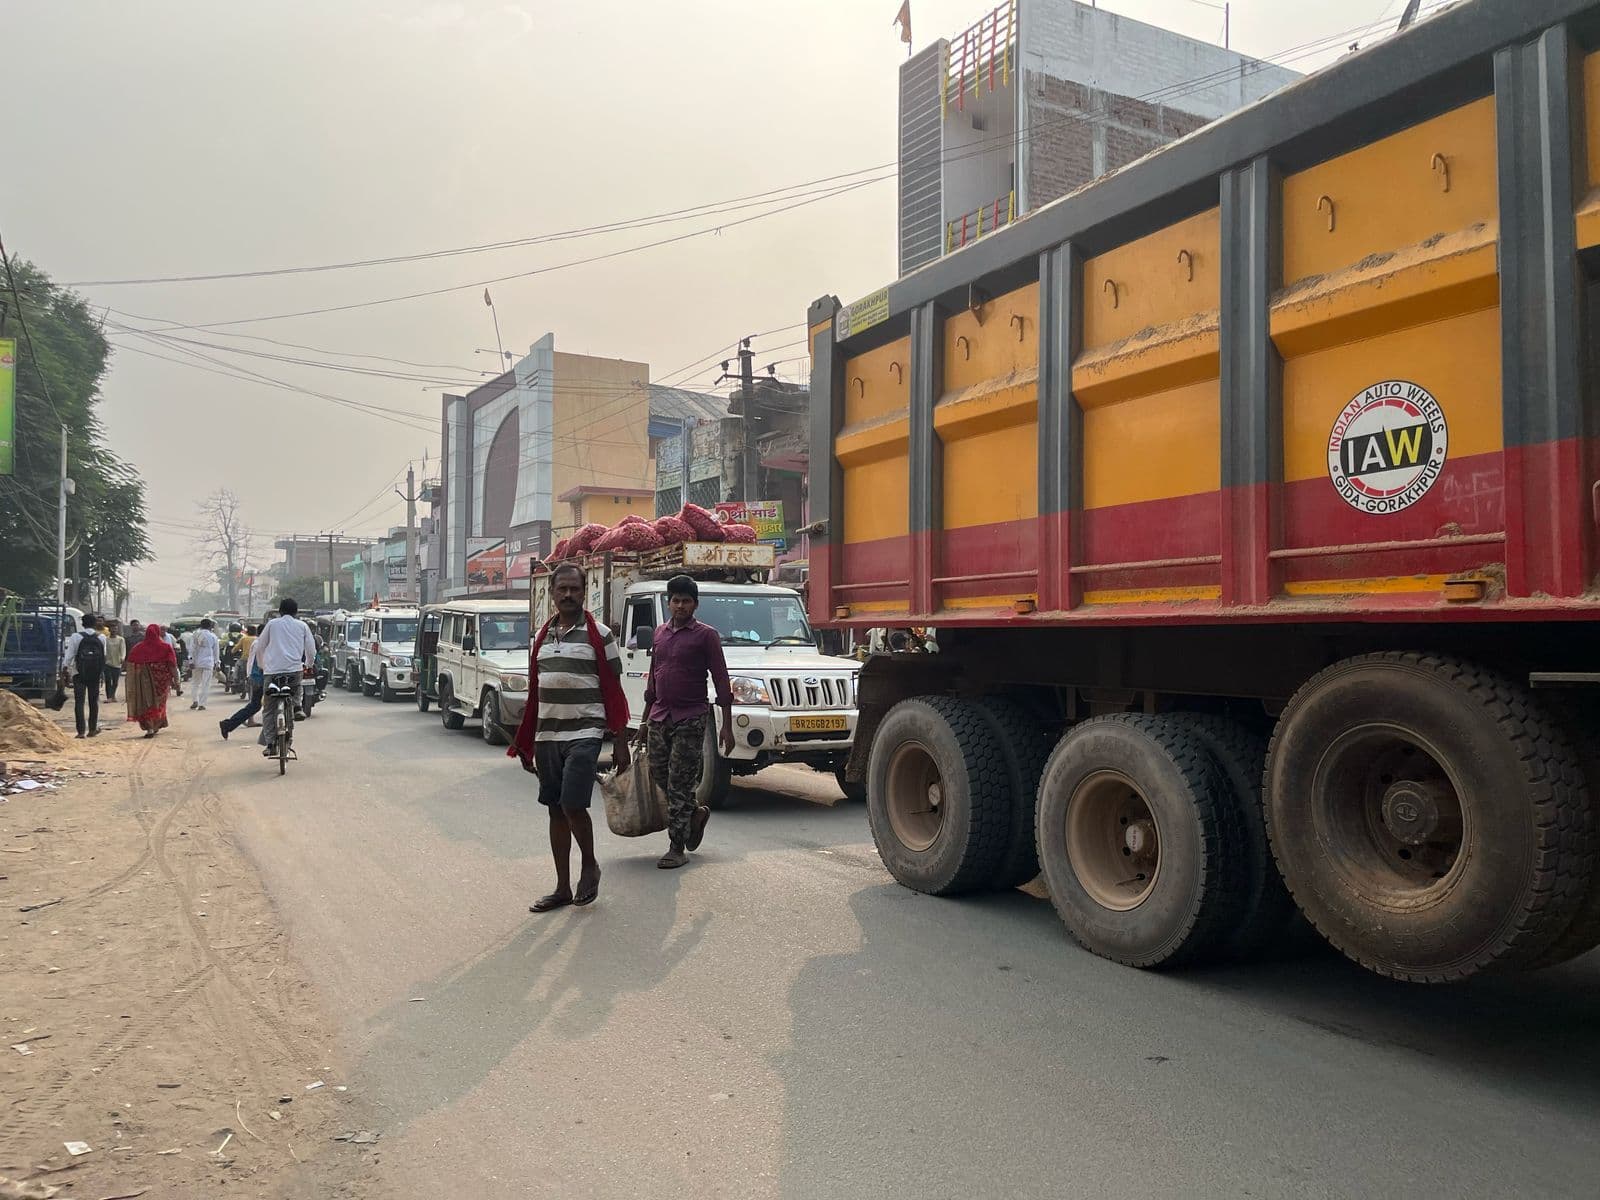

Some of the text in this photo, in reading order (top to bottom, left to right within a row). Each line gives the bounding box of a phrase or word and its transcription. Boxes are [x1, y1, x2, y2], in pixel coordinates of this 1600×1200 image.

[1330, 383, 1445, 452] INDIAN AUTO WHEELS
[1347, 426, 1423, 474] IAW
[1335, 459, 1441, 513] GIDA-GORAKHPUR
[730, 506, 748, 520] श्री
[703, 545, 754, 563] श्री हरि
[795, 719, 845, 729] BR26GB2197
